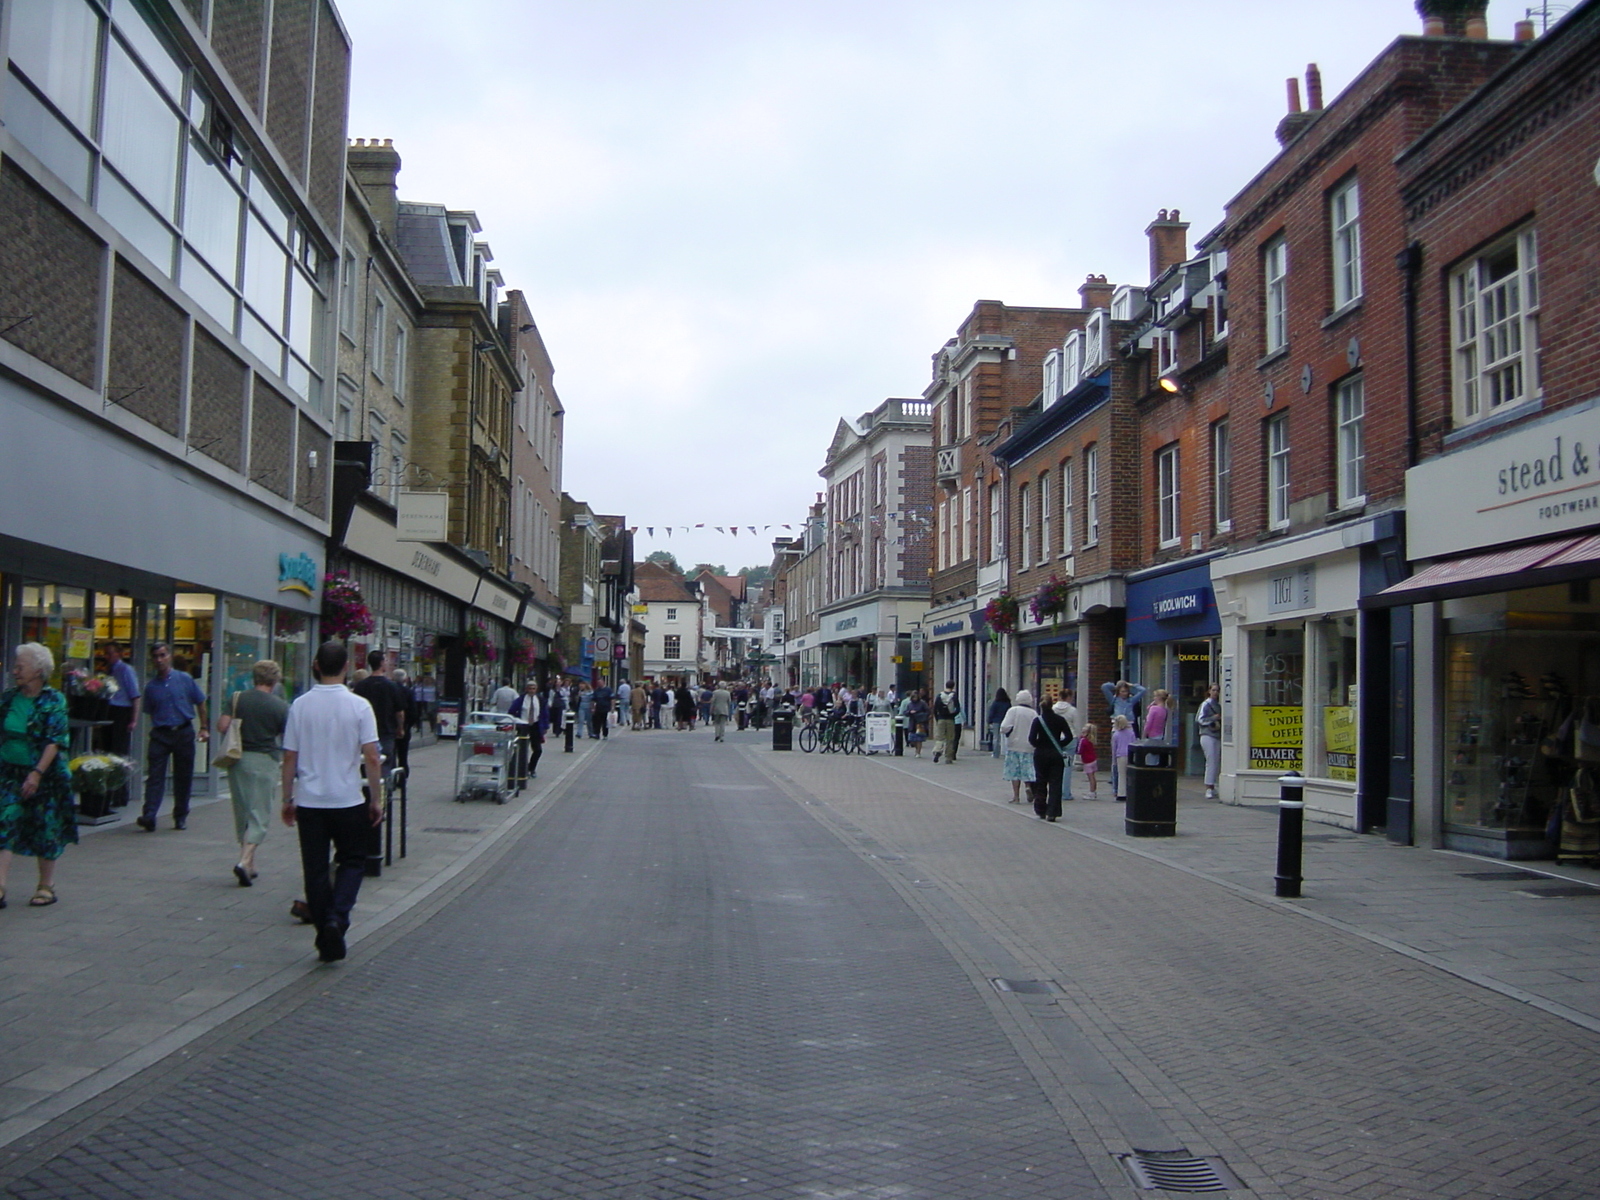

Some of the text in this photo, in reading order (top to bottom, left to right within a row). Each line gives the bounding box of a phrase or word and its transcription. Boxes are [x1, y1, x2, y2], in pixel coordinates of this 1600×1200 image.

[1498, 436, 1563, 494] stead
[1572, 441, 1589, 476] &
[1538, 496, 1598, 519] FOOTWEAR
[1273, 576, 1292, 604] TIGI
[1159, 594, 1196, 613] WOOLWICH
[1178, 654, 1199, 662] QUICK
[1251, 748, 1296, 760] PALMER
[1256, 759, 1285, 769] 01962
